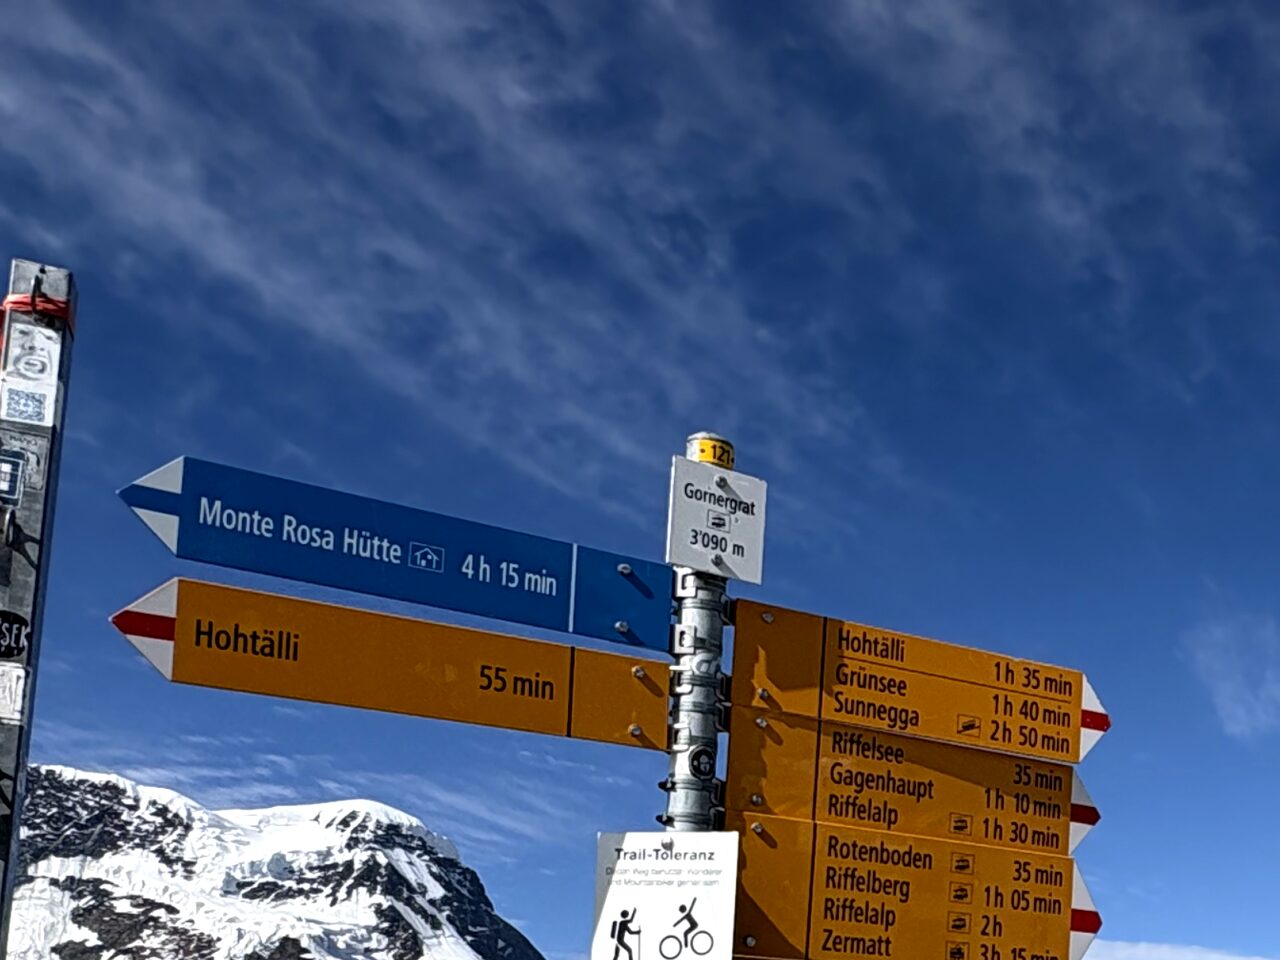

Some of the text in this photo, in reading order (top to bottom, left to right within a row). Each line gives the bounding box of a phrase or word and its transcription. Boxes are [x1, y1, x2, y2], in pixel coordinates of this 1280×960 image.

[684, 482, 756, 516] Gornergrat
[199, 497, 557, 596] Monte Rosa Hütte 4 h 15 min
[690, 529, 745, 557] 3'090 m
[195, 618, 554, 700] Hohtälli 55 min
[838, 627, 1072, 697] Hohtälli 1 h 35 min
[834, 691, 1069, 754] Sunnegga 2 h 50 min
[835, 663, 1071, 728] Grünsee 1 h 40 min
[832, 731, 1062, 792] Riffelsee 35 min
[830, 762, 1061, 819] Gagenhaupt 1 h 10 min
[828, 794, 1060, 849] Riffelalp 1 h 30 min
[614, 847, 716, 861] Trail-Toleranz
[827, 835, 1063, 887] Rotenboden 35 min
[824, 897, 1003, 937] Riffelalp 2 h
[825, 866, 1061, 915] Riffelberg 1 h 05 min
[821, 928, 892, 957] Zermatt
